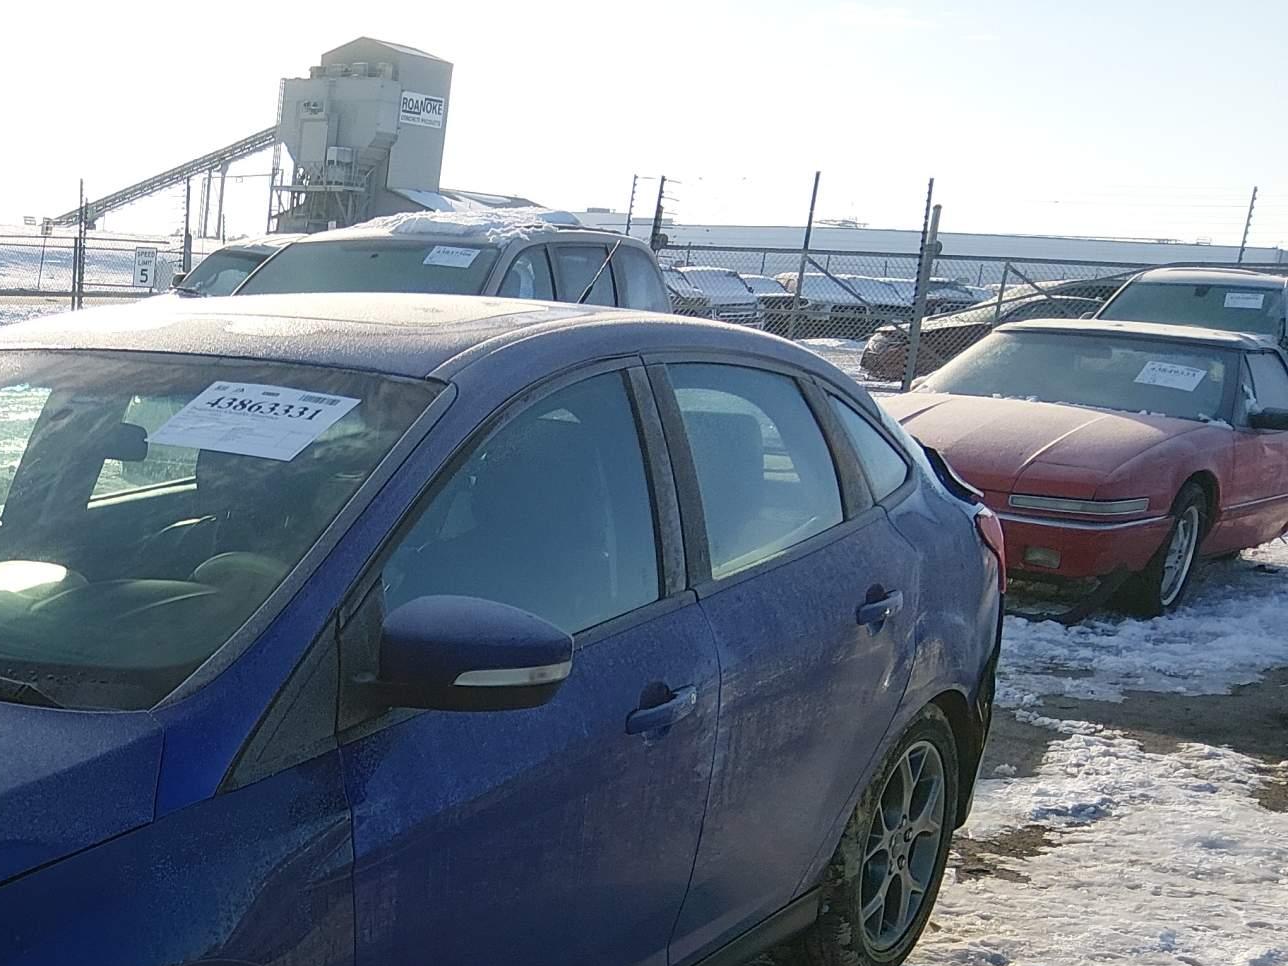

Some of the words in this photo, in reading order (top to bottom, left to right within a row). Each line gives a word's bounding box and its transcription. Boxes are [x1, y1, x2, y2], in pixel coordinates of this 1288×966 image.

[402, 97, 443, 116] ROANOKE
[139, 268, 149, 284] 5
[206, 396, 322, 421] 43863331
